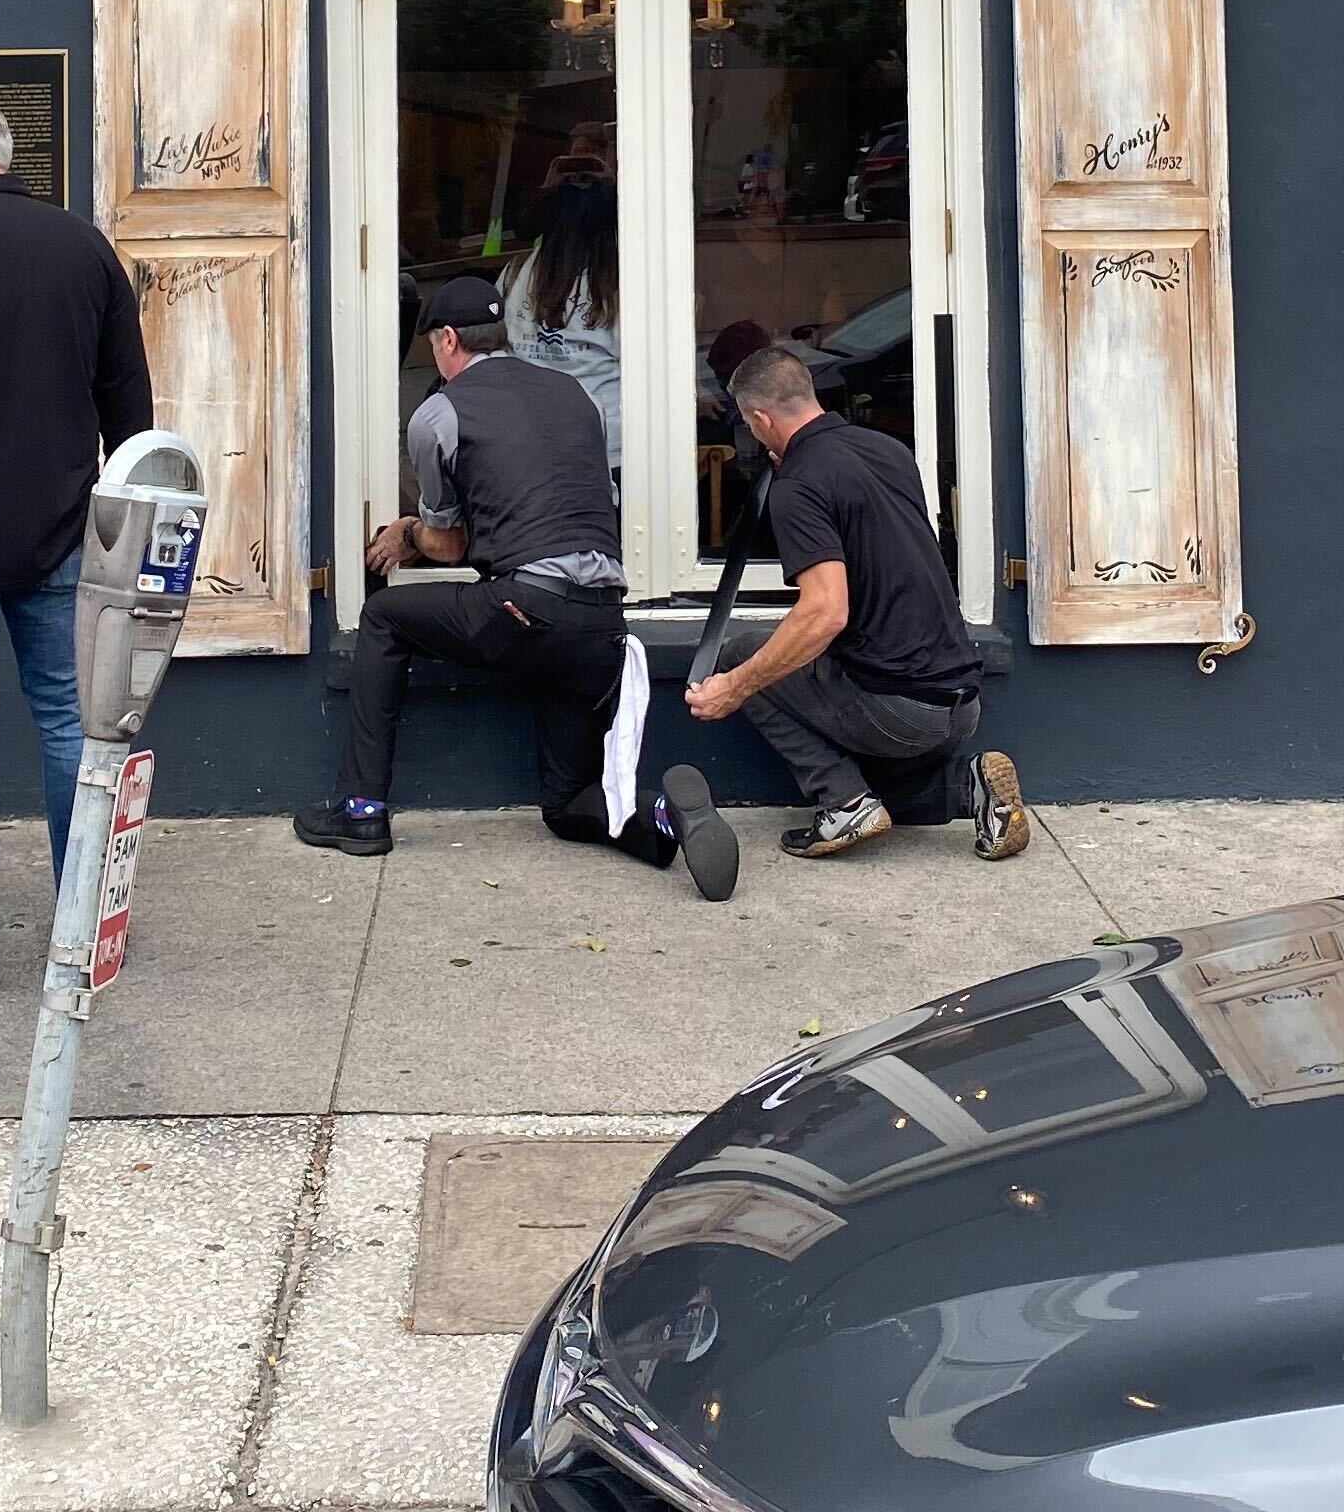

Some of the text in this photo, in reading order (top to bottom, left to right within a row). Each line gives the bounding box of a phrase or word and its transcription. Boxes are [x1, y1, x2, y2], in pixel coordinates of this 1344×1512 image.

[174, 122, 243, 175] Music
[1082, 112, 1171, 176] Henry's
[201, 154, 242, 181] Nightly
[113, 831, 139, 865] 5AM
[107, 880, 130, 914] 7AM
